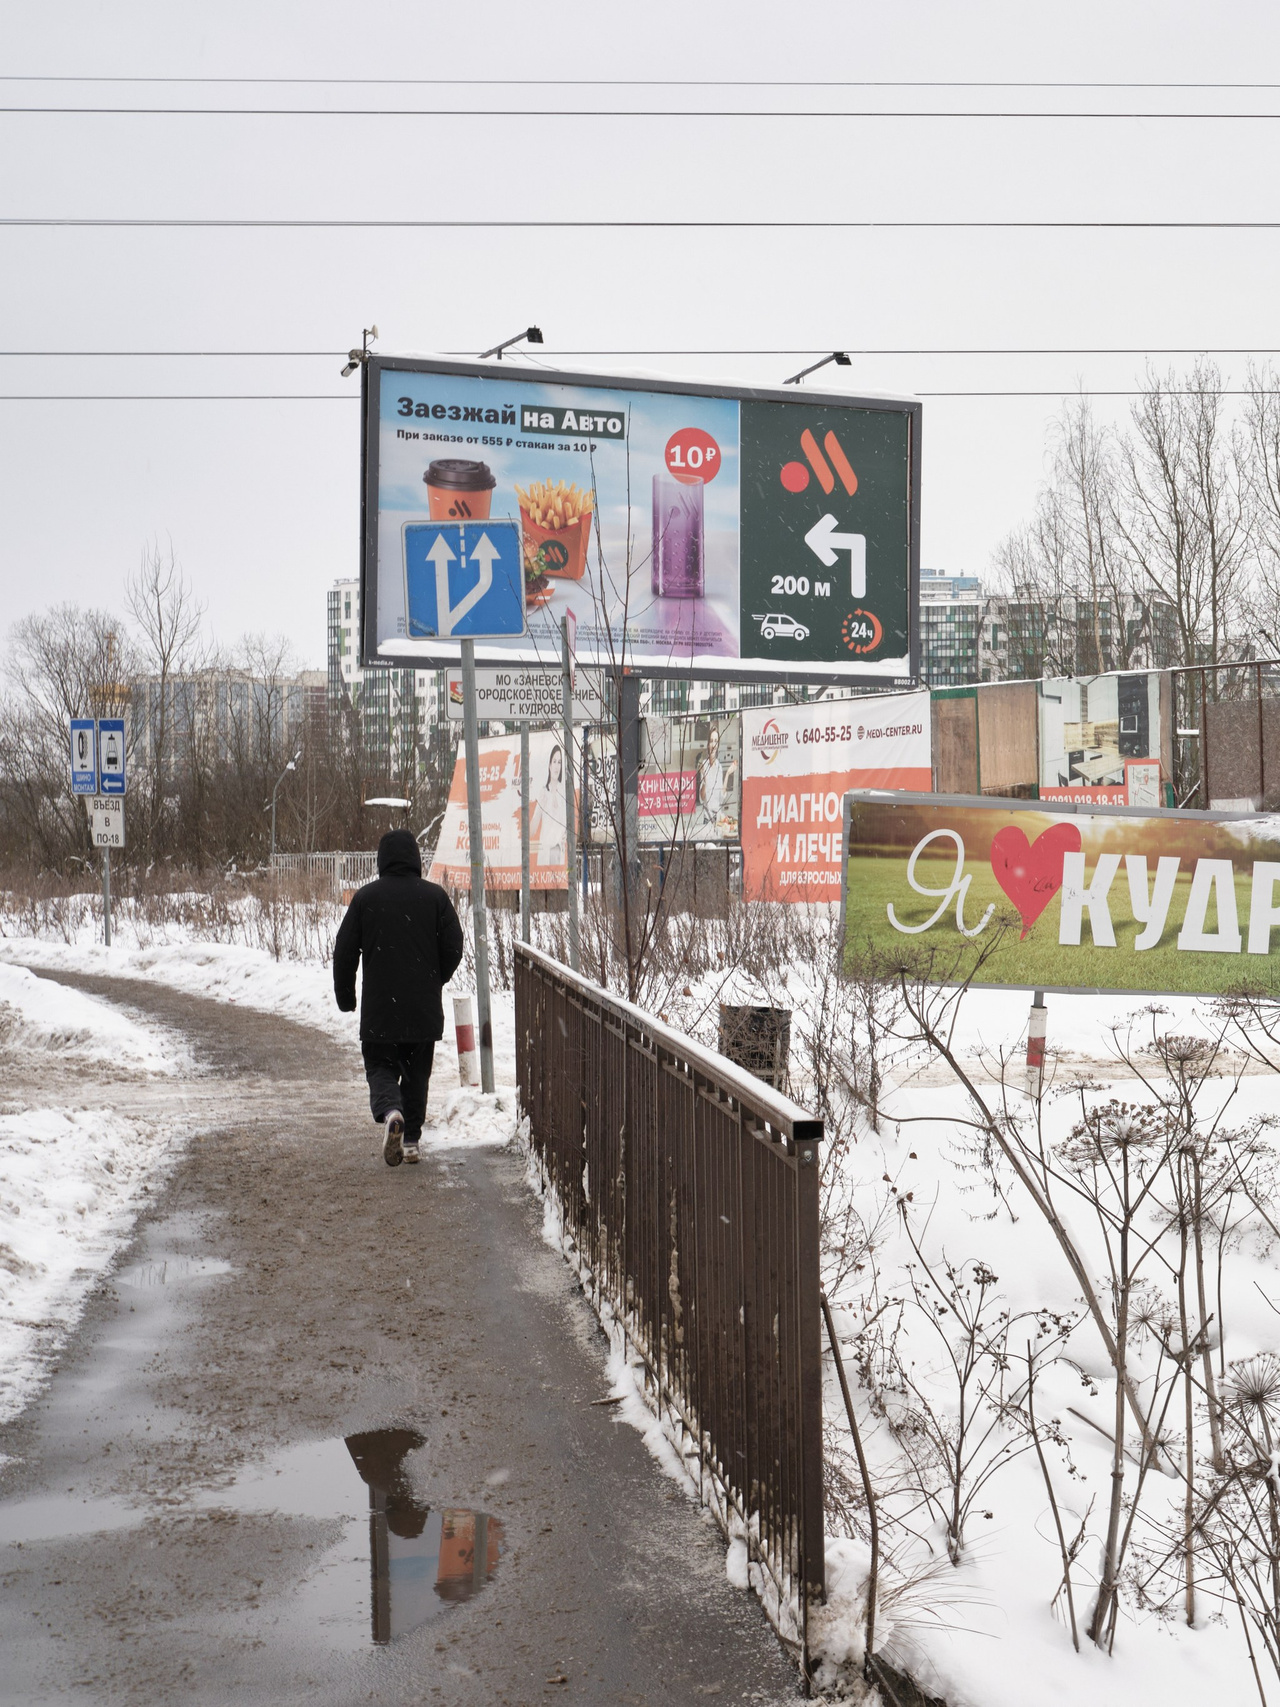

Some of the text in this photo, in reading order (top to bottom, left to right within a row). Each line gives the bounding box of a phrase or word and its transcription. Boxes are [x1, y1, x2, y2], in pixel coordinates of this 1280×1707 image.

[397, 397, 622, 434] Заезжай на Авто
[397, 429, 420, 440] При
[422, 433, 464, 443] заказе
[466, 436, 479, 444] от
[482, 436, 503, 446] 555
[506, 438, 513, 447] ₽
[515, 440, 555, 450] стакан
[557, 443, 570, 451] за
[573, 443, 587, 452] 10
[771, 575, 810, 596] 200
[496, 674, 511, 686] МО
[476, 688, 600, 702] ОРОДСКОЕ ПОСЕЕНИЕ»
[510, 703, 565, 716] Г. КУДРОВО
[802, 726, 852, 744] 640-55-25
[866, 724, 923, 740] MEDI-CENTER.RU
[76, 774, 92, 782] ШИНО
[659, 777, 694, 792] ШКАФЫ
[74, 784, 95, 792] МОНТАЖ
[93, 800, 120, 812] ВЪЕЗД
[104, 817, 110, 827] В
[97, 834, 120, 844] ПО-18
[777, 834, 790, 863] И
[779, 871, 842, 886] ДЛЯ ВЗРОСЛЫХ
[887, 828, 996, 937] Я
